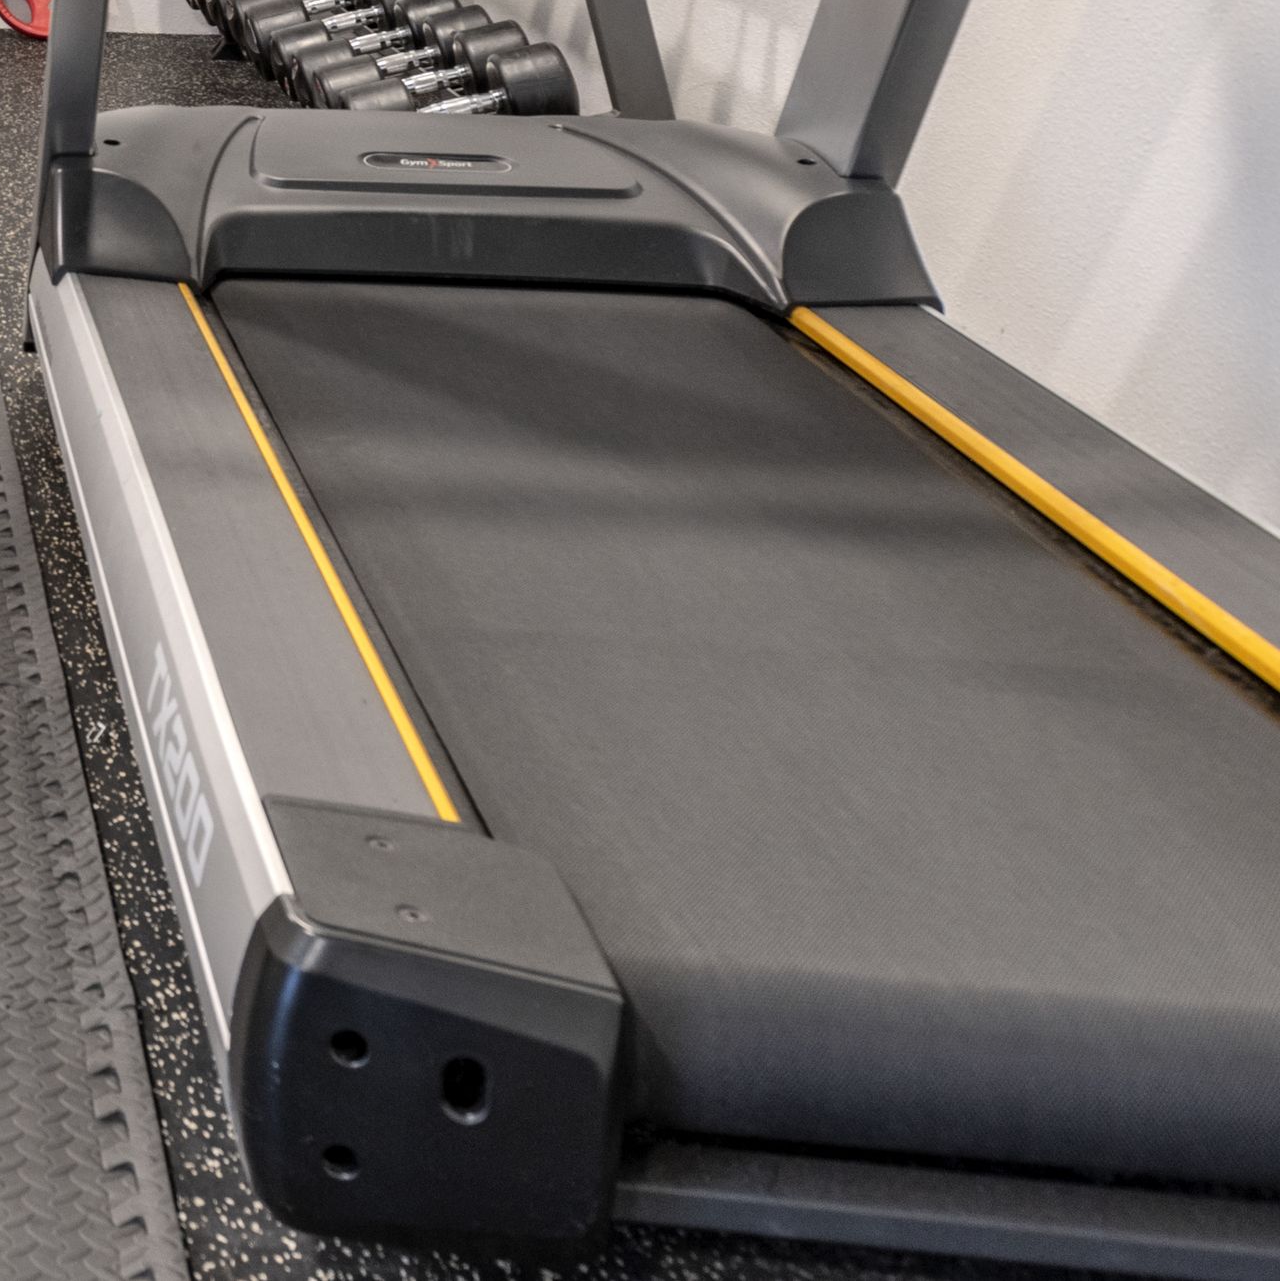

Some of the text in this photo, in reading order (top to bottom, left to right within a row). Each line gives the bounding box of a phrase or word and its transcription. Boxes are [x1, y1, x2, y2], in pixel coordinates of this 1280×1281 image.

[400, 158, 473, 168] Gym Sport
[146, 641, 215, 889] TX200
